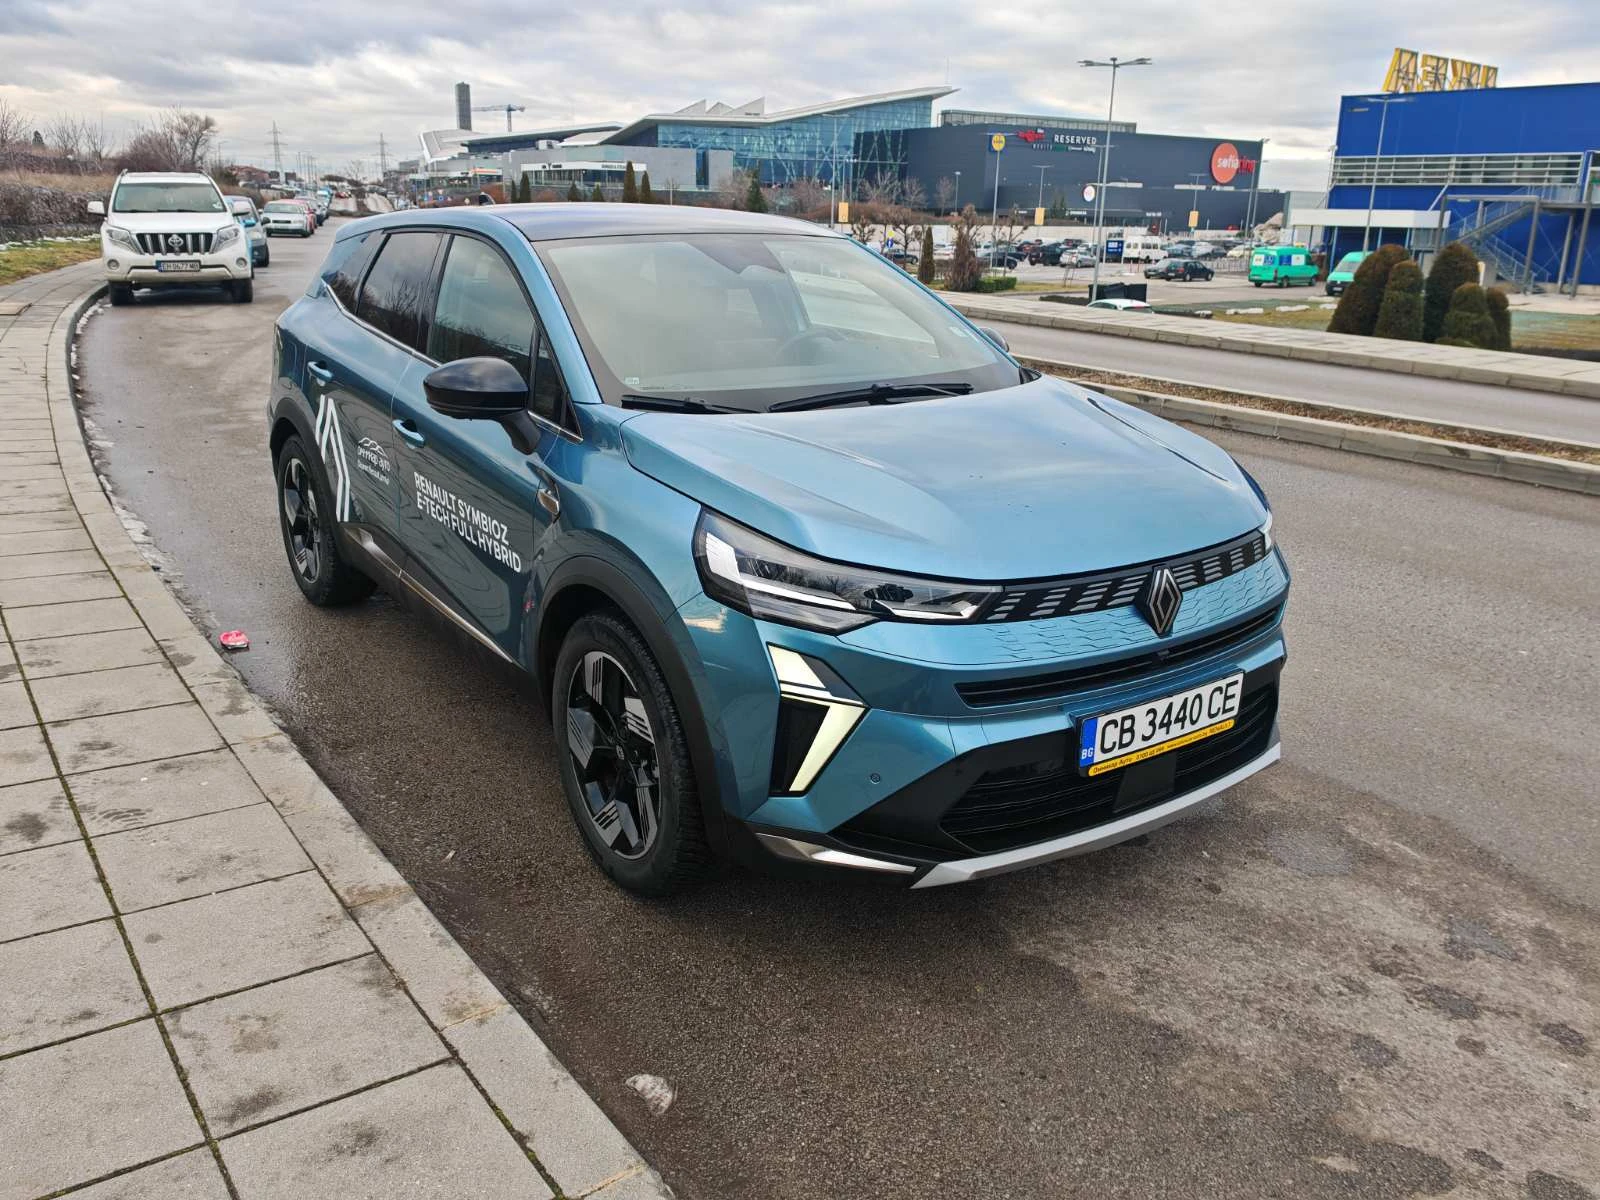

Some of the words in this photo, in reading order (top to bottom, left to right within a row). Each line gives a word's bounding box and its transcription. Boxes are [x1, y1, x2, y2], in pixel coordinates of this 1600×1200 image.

[1054, 134, 1097, 145] RESERVED
[414, 471, 456, 513] RENAULT
[457, 498, 510, 545] SYMBIOZ
[416, 491, 451, 528] E-TECH
[450, 513, 478, 546] FULL
[478, 530, 522, 573] HYBRID
[1081, 746, 1094, 760] BG
[1100, 713, 1136, 755] CB
[1142, 693, 1203, 742] 3440
[1207, 679, 1239, 720] CE
